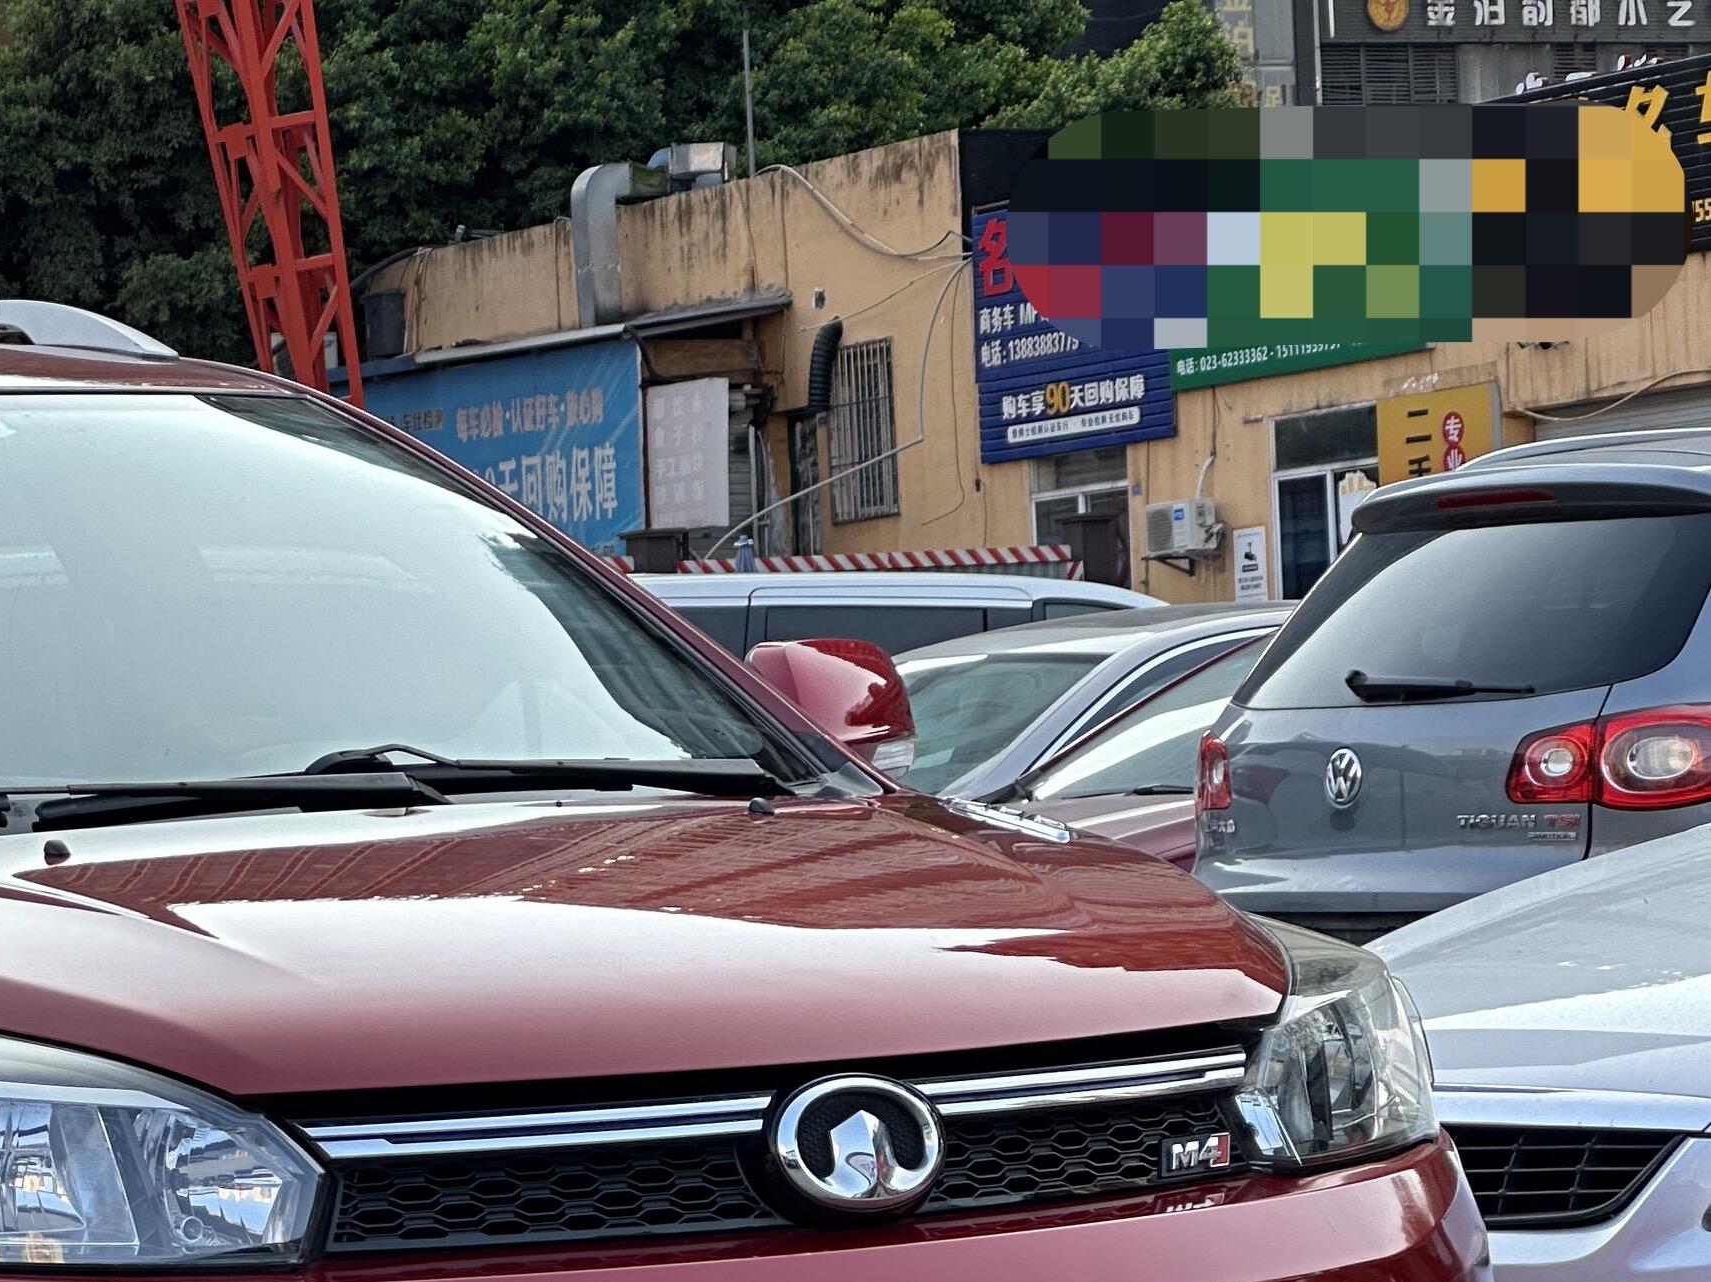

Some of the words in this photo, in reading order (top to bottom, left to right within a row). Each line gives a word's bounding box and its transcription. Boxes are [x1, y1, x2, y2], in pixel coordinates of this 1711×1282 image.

[979, 304, 1015, 335] 商务车
[1002, 374, 1146, 420] 购车享90天回购保障
[1456, 813, 1537, 829] TIGUAN
[1171, 1134, 1226, 1171] M4
